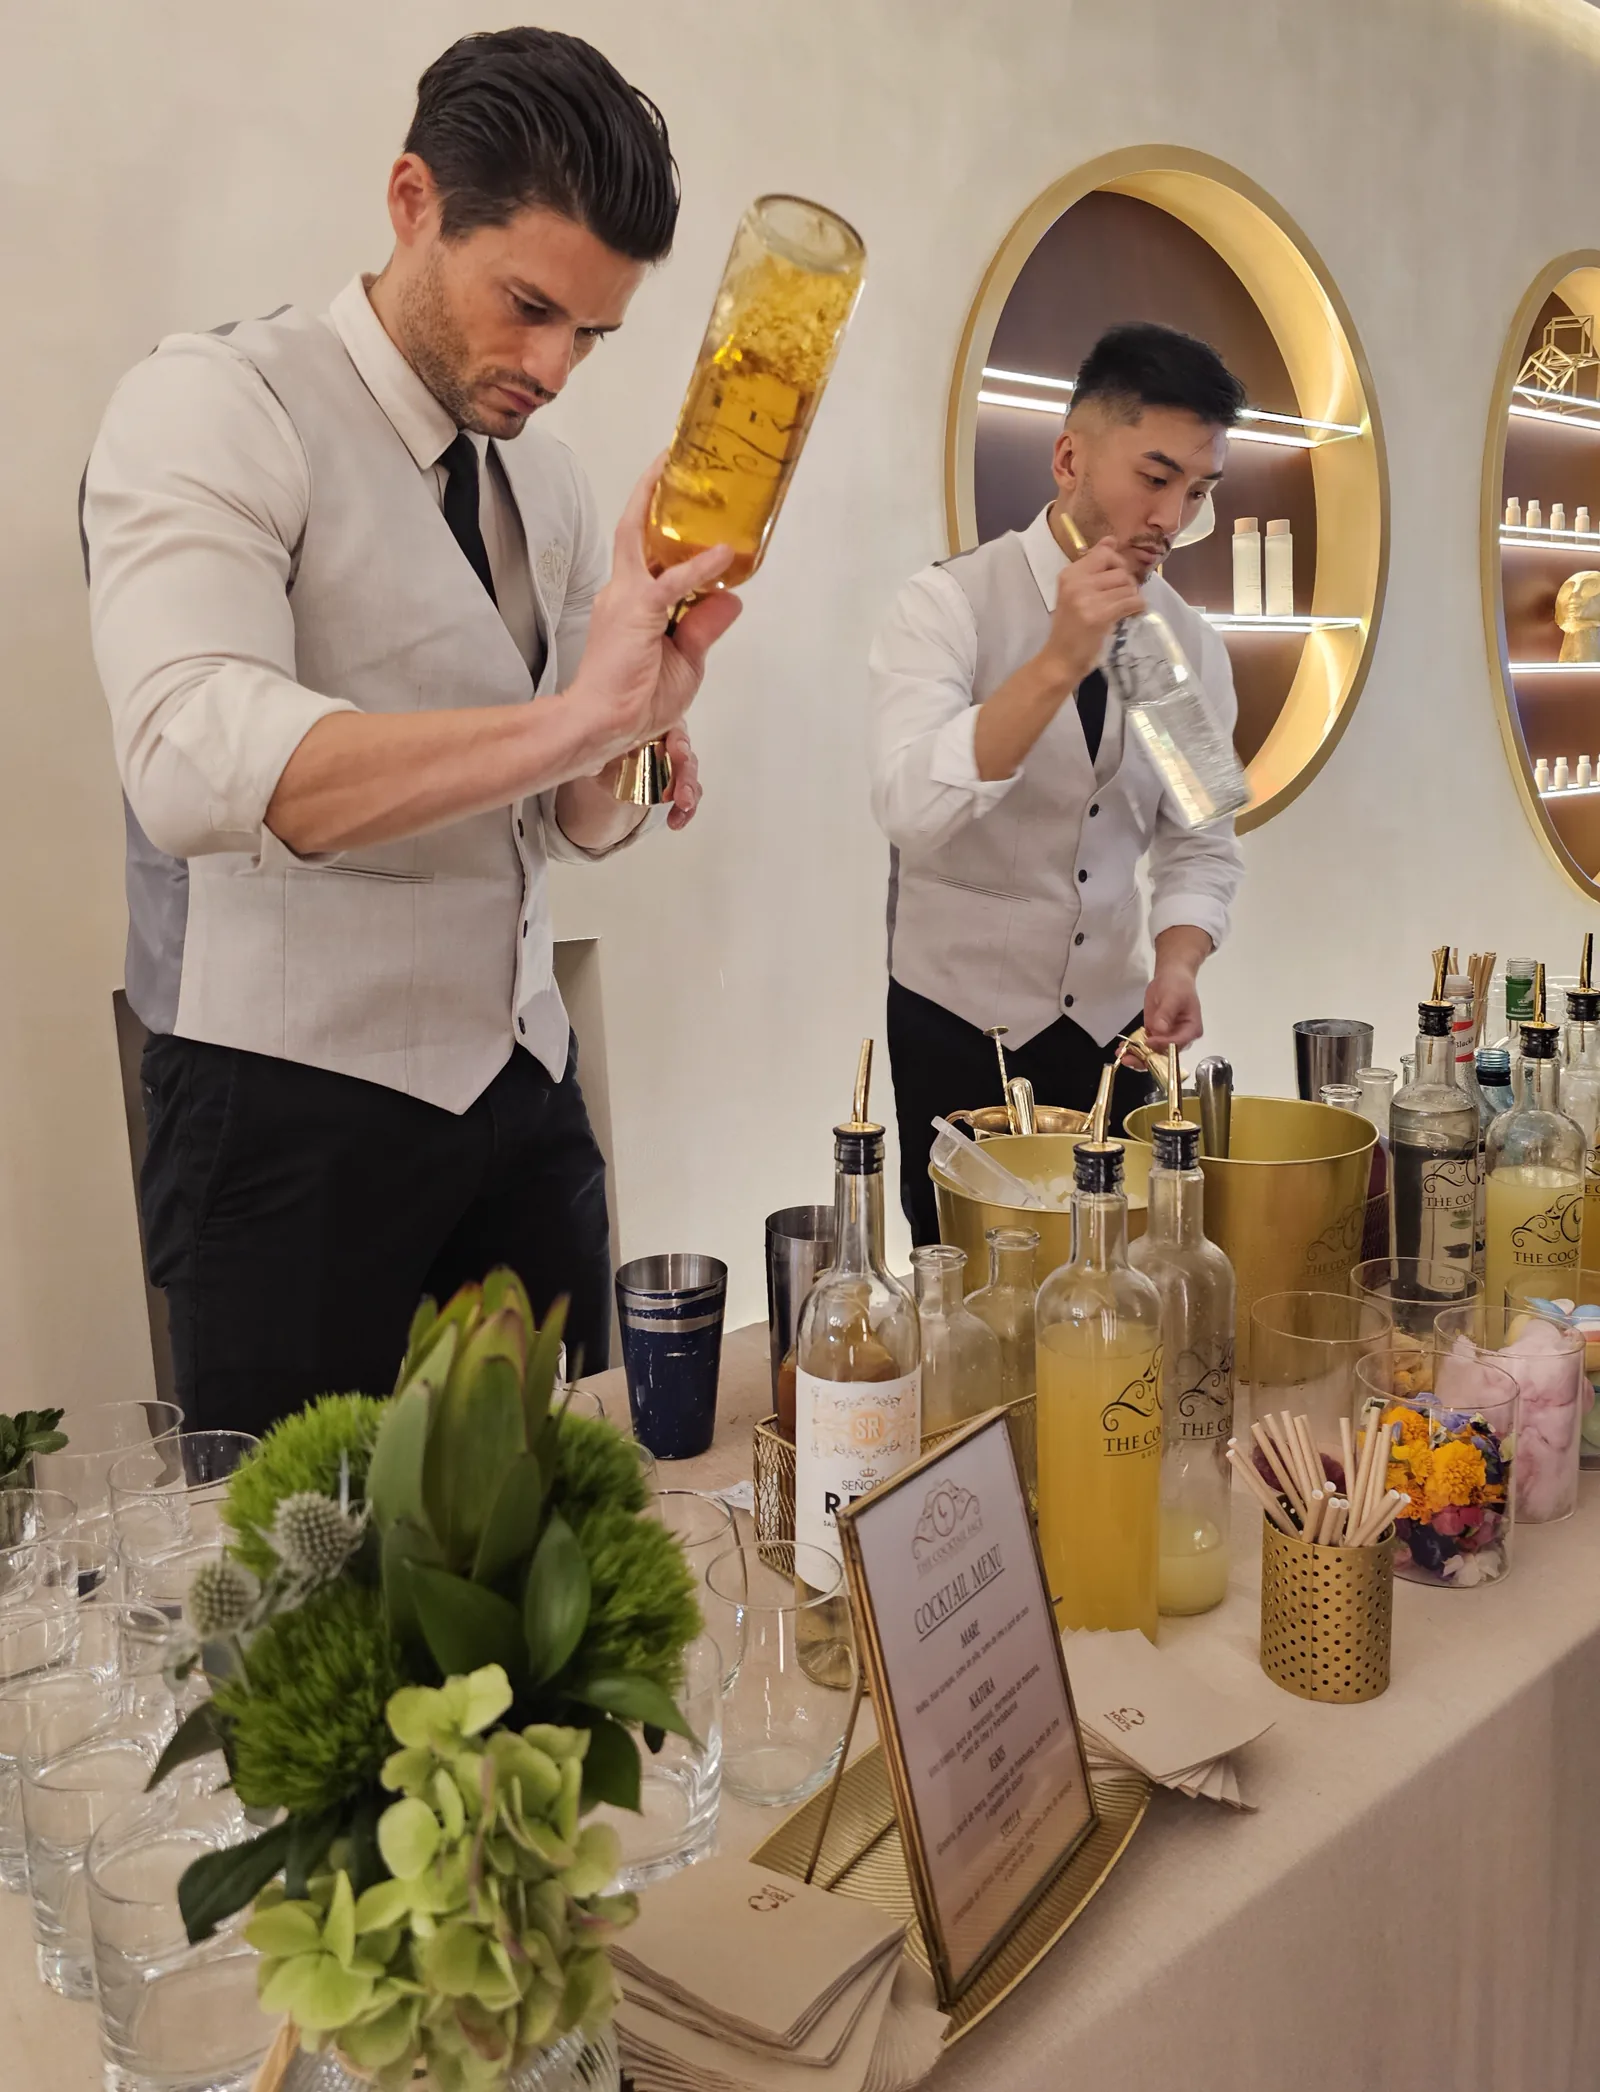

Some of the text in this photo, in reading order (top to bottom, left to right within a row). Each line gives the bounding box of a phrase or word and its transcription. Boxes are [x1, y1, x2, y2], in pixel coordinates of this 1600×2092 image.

[1424, 1197, 1452, 1206] THE
[1513, 1251, 1544, 1264] THE
[856, 1417, 880, 1439] SR
[1180, 1421, 1214, 1436] THE
[1103, 1434, 1140, 1453] THE
[914, 1543, 1004, 1635] COCKTAIL MENU
[960, 1618, 981, 1649] MARE
[968, 1675, 996, 1711] NATURA
